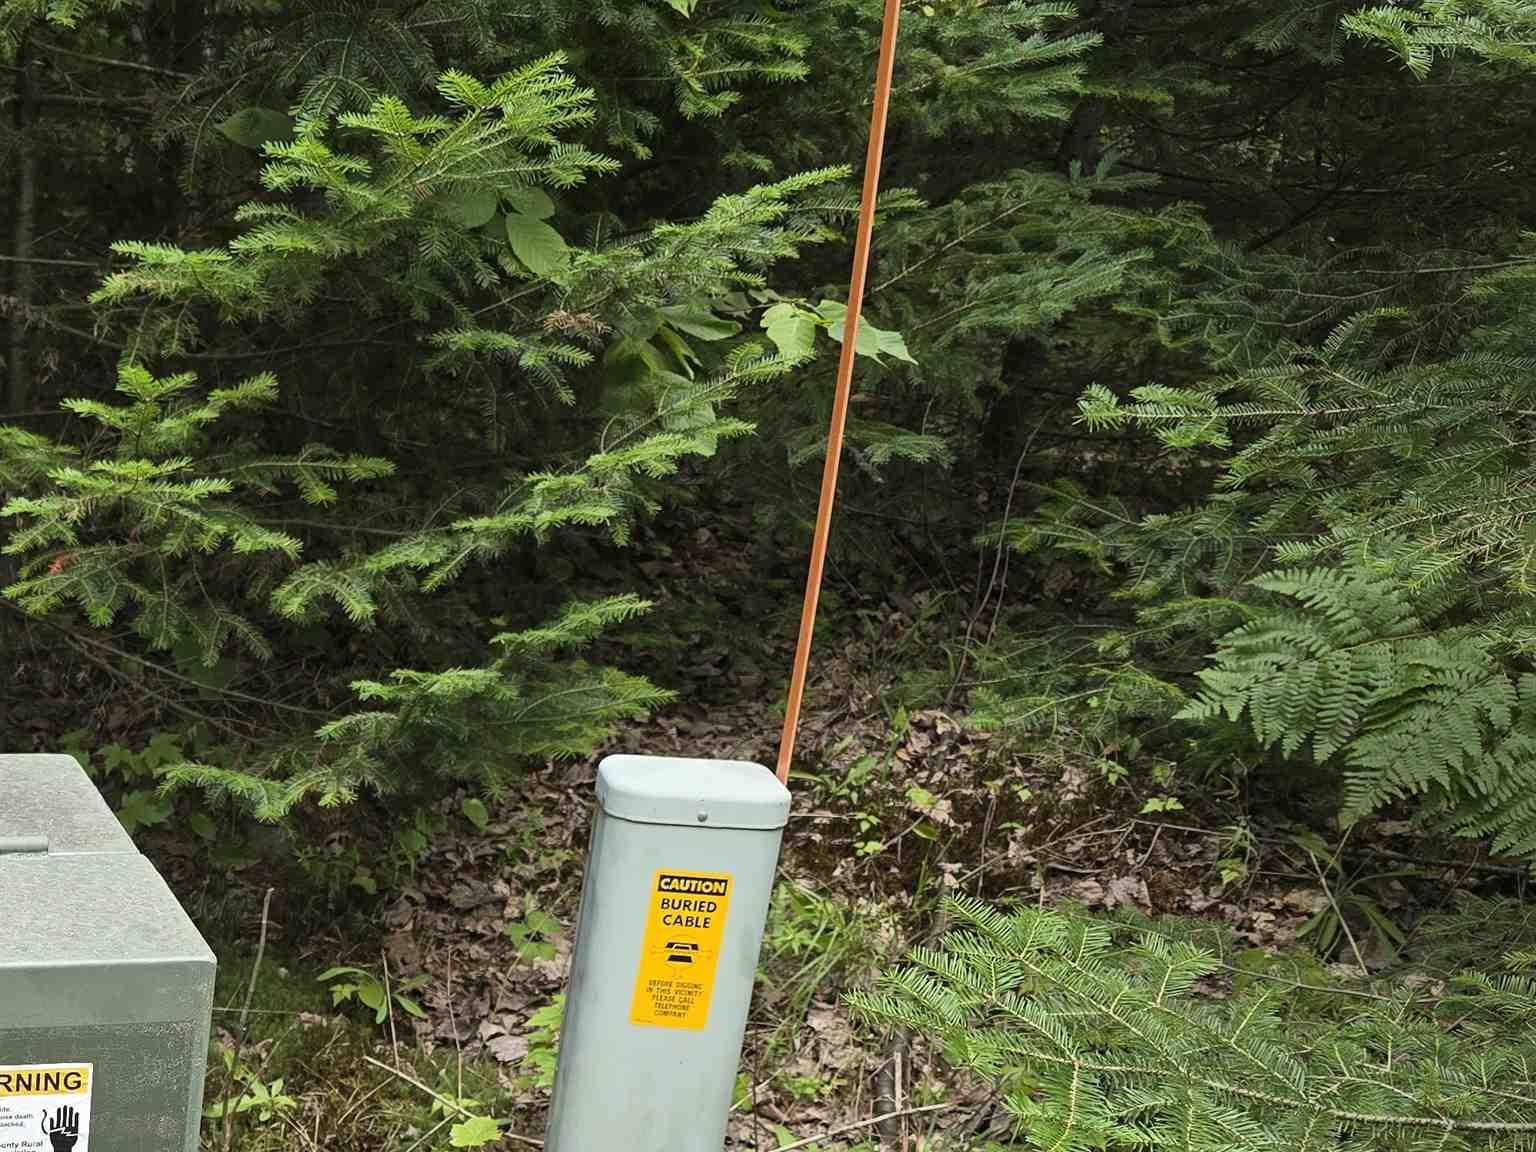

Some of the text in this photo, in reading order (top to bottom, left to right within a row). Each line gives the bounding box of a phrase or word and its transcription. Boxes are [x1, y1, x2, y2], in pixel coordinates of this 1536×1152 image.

[660, 878, 726, 894] CAUTION
[661, 898, 717, 913] BURIED
[663, 914, 712, 929] CABLE
